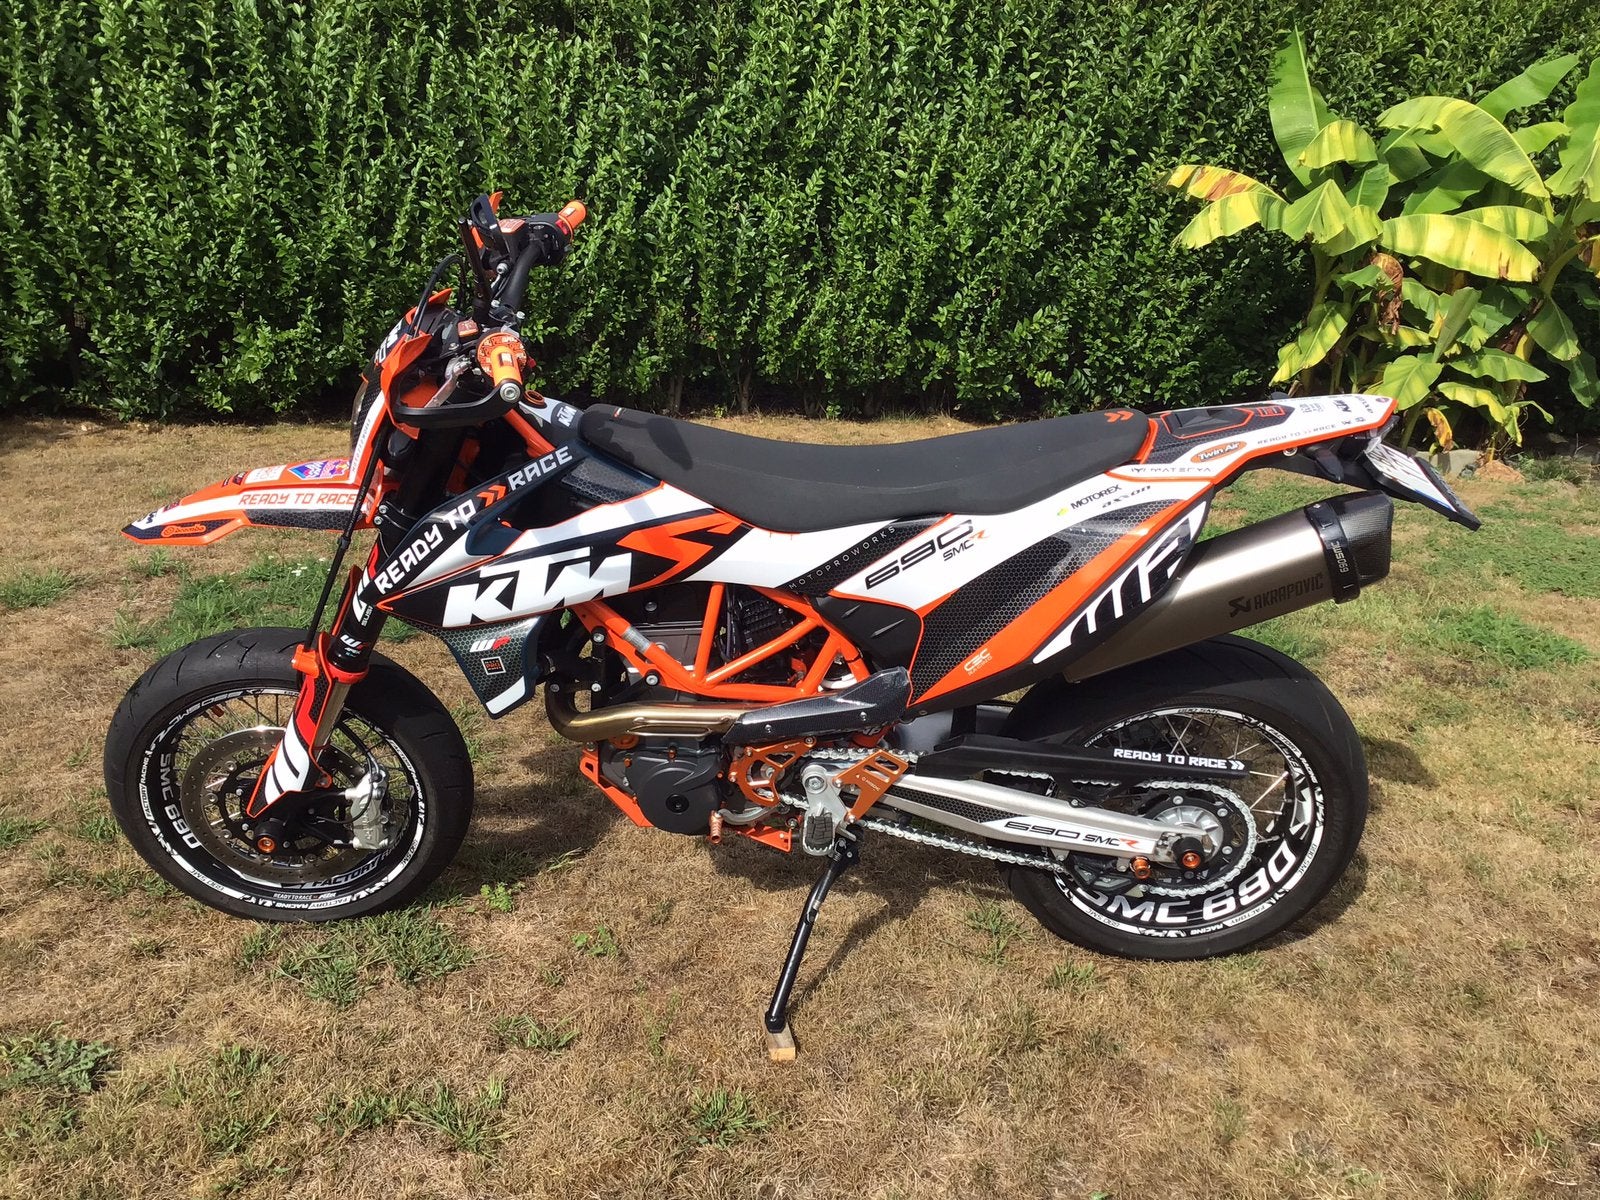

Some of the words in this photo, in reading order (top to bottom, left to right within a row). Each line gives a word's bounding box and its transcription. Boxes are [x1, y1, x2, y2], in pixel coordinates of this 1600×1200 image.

[556, 405, 577, 427] KTM
[1198, 447, 1224, 460] Twin
[1225, 442, 1240, 453] Air
[239, 494, 290, 506] READY
[294, 493, 314, 505] TO
[316, 493, 357, 505] RACE
[1070, 484, 1122, 510] MOTOREX
[373, 526, 444, 595] READY
[443, 499, 477, 531] TO
[507, 446, 573, 491] RACE
[789, 525, 896, 590] MOTOPROWORKS
[865, 519, 974, 590] 690
[1331, 540, 1349, 574] 690SMC
[442, 546, 632, 627] KTM
[1113, 748, 1161, 763] READY
[1166, 753, 1185, 766] TO
[1188, 756, 1228, 770] RACE
[160, 753, 174, 801] SMC
[164, 804, 202, 849] 690
[1004, 821, 1081, 840] 690
[312, 861, 377, 887] FACTORY
[1202, 839, 1297, 921] 690
[276, 901, 309, 910] RACING
[1190, 923, 1224, 936] RACING
